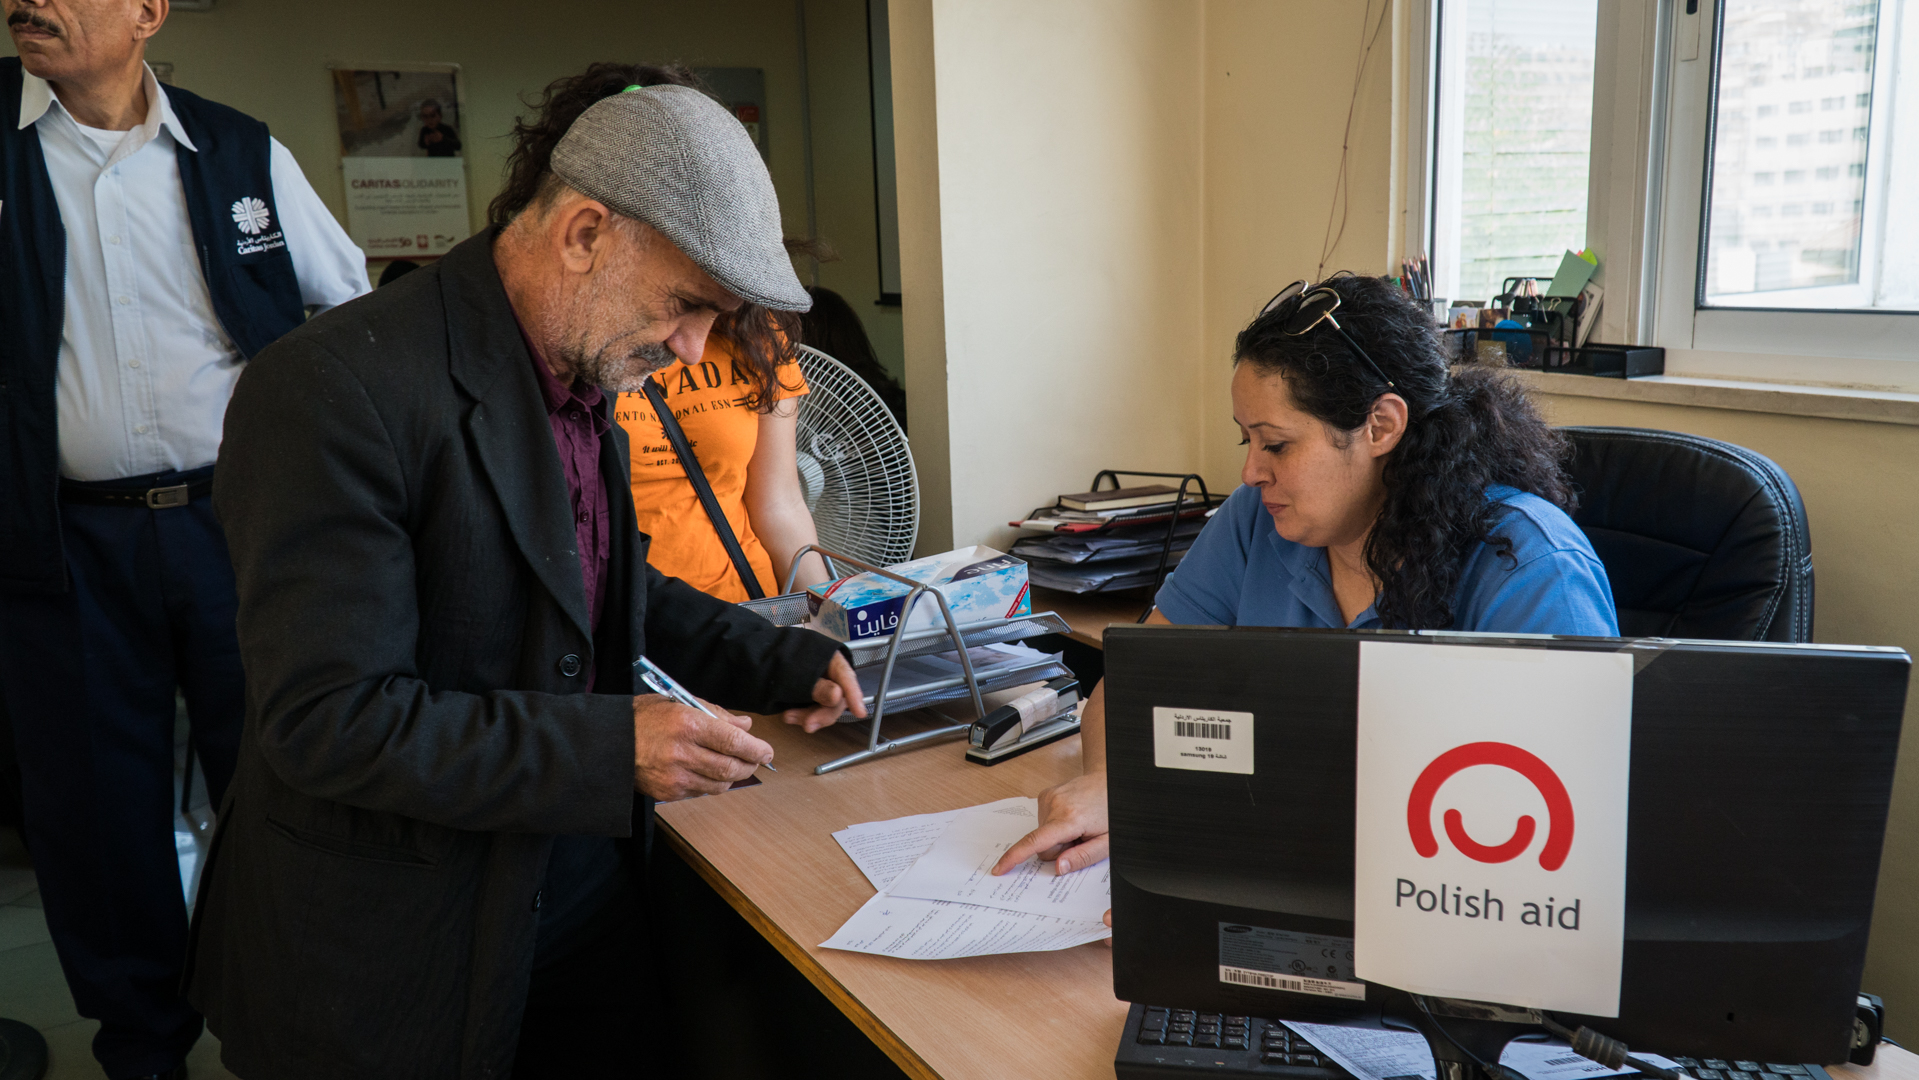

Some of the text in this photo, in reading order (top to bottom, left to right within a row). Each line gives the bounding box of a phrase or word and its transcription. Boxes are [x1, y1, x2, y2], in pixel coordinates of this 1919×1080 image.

[237, 240, 285, 255] Caritas Jordan
[615, 411, 646, 422] ENTO
[711, 398, 732, 411] ESN
[1396, 877, 1581, 931] Polish aid
